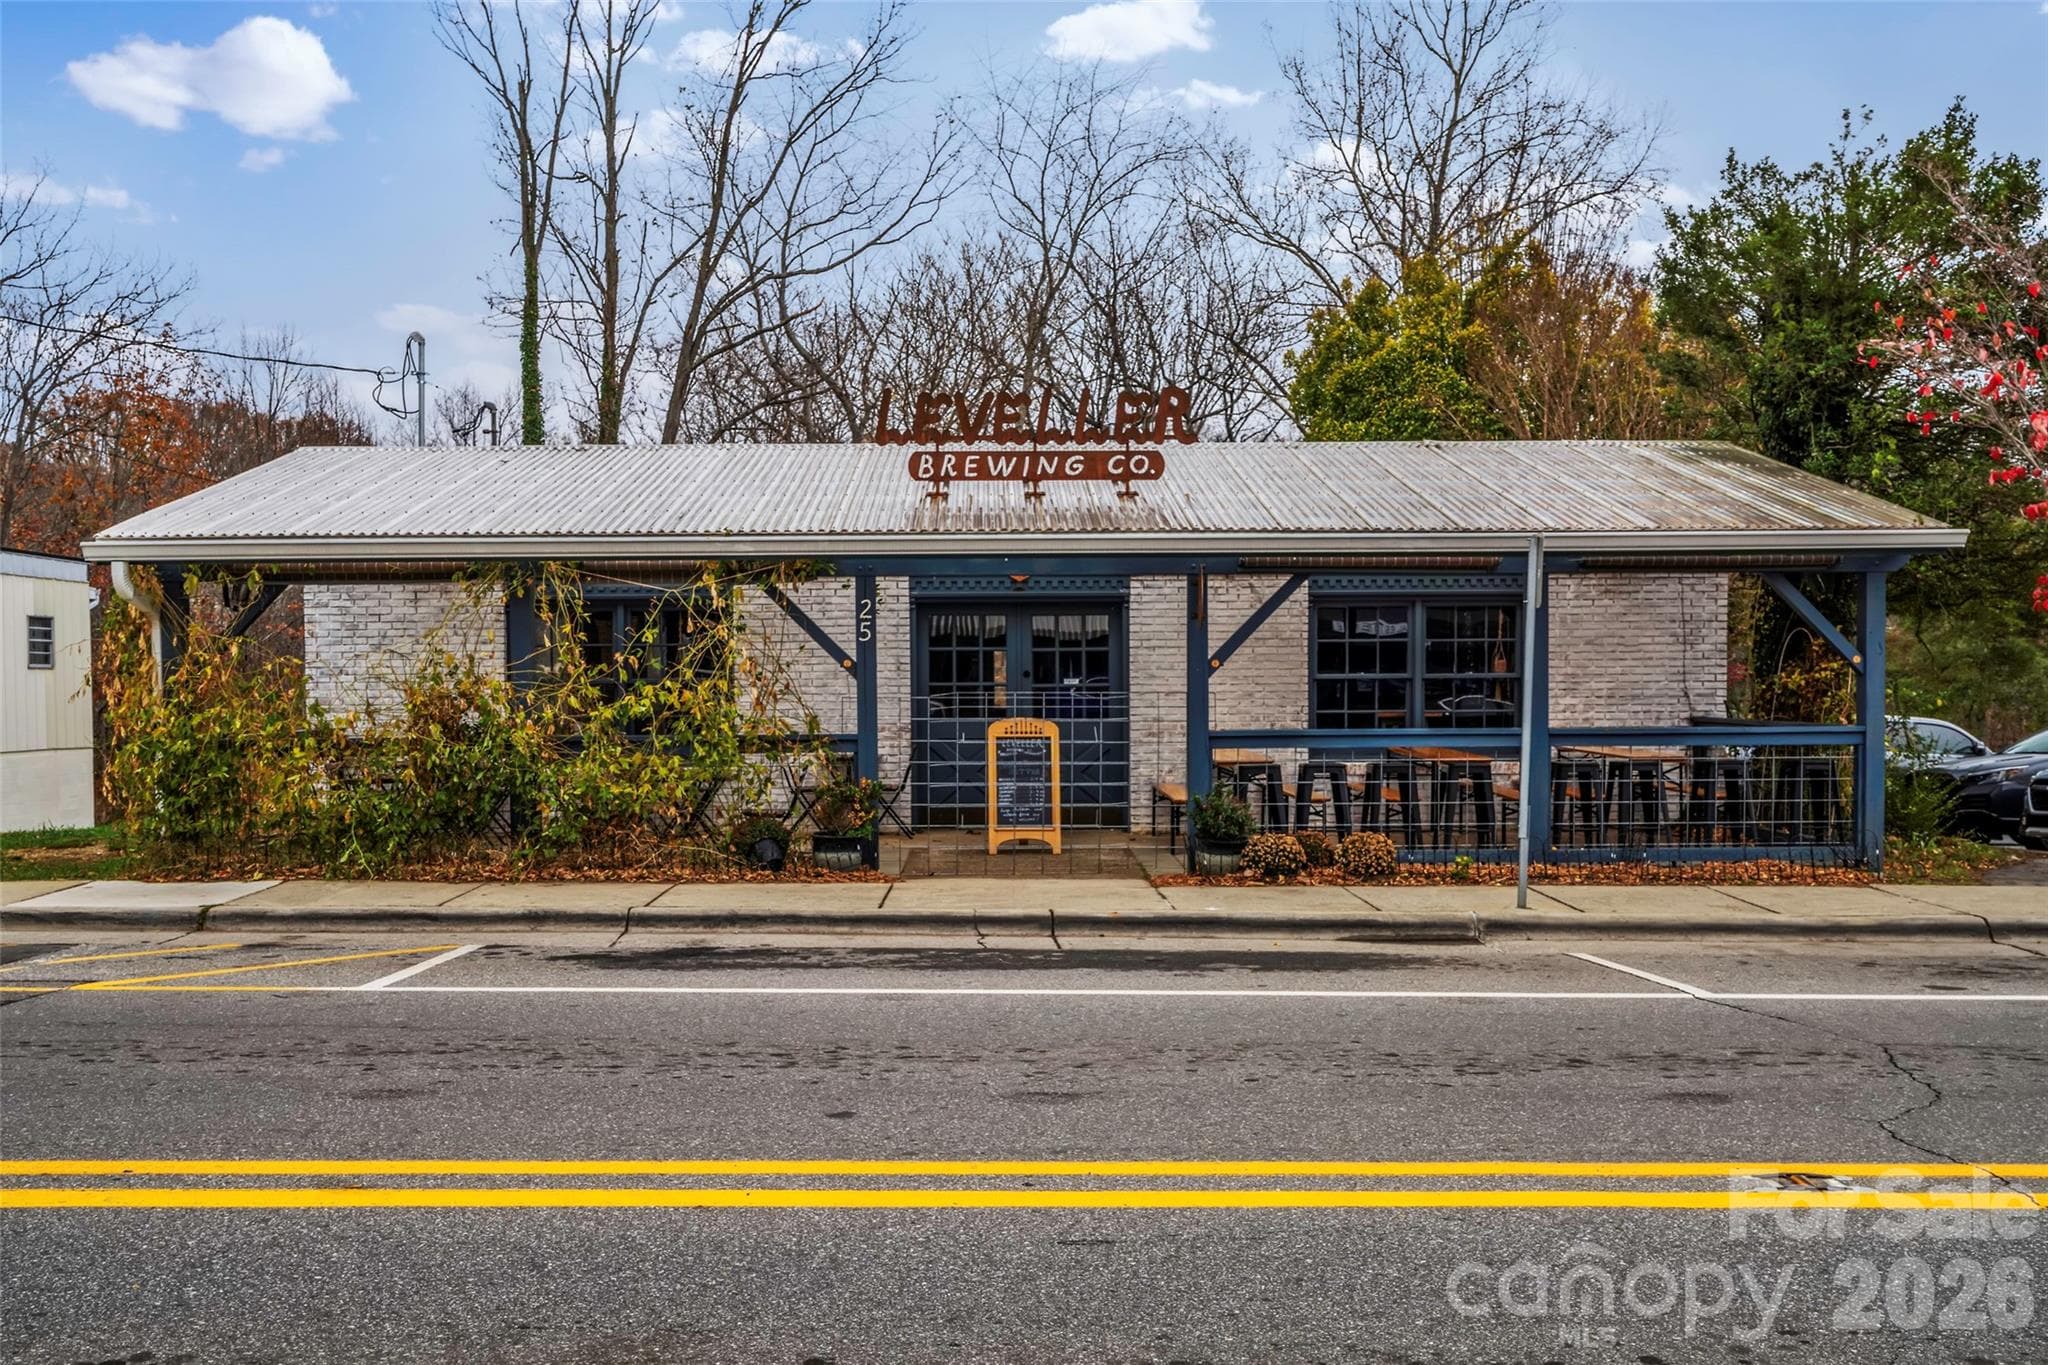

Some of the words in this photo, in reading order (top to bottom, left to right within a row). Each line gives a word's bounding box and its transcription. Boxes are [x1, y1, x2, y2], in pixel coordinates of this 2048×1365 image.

[875, 387, 1199, 445] LEVELLER
[919, 454, 1084, 477] BREWING
[1108, 454, 1155, 475] CO.
[859, 599, 872, 641] 25
